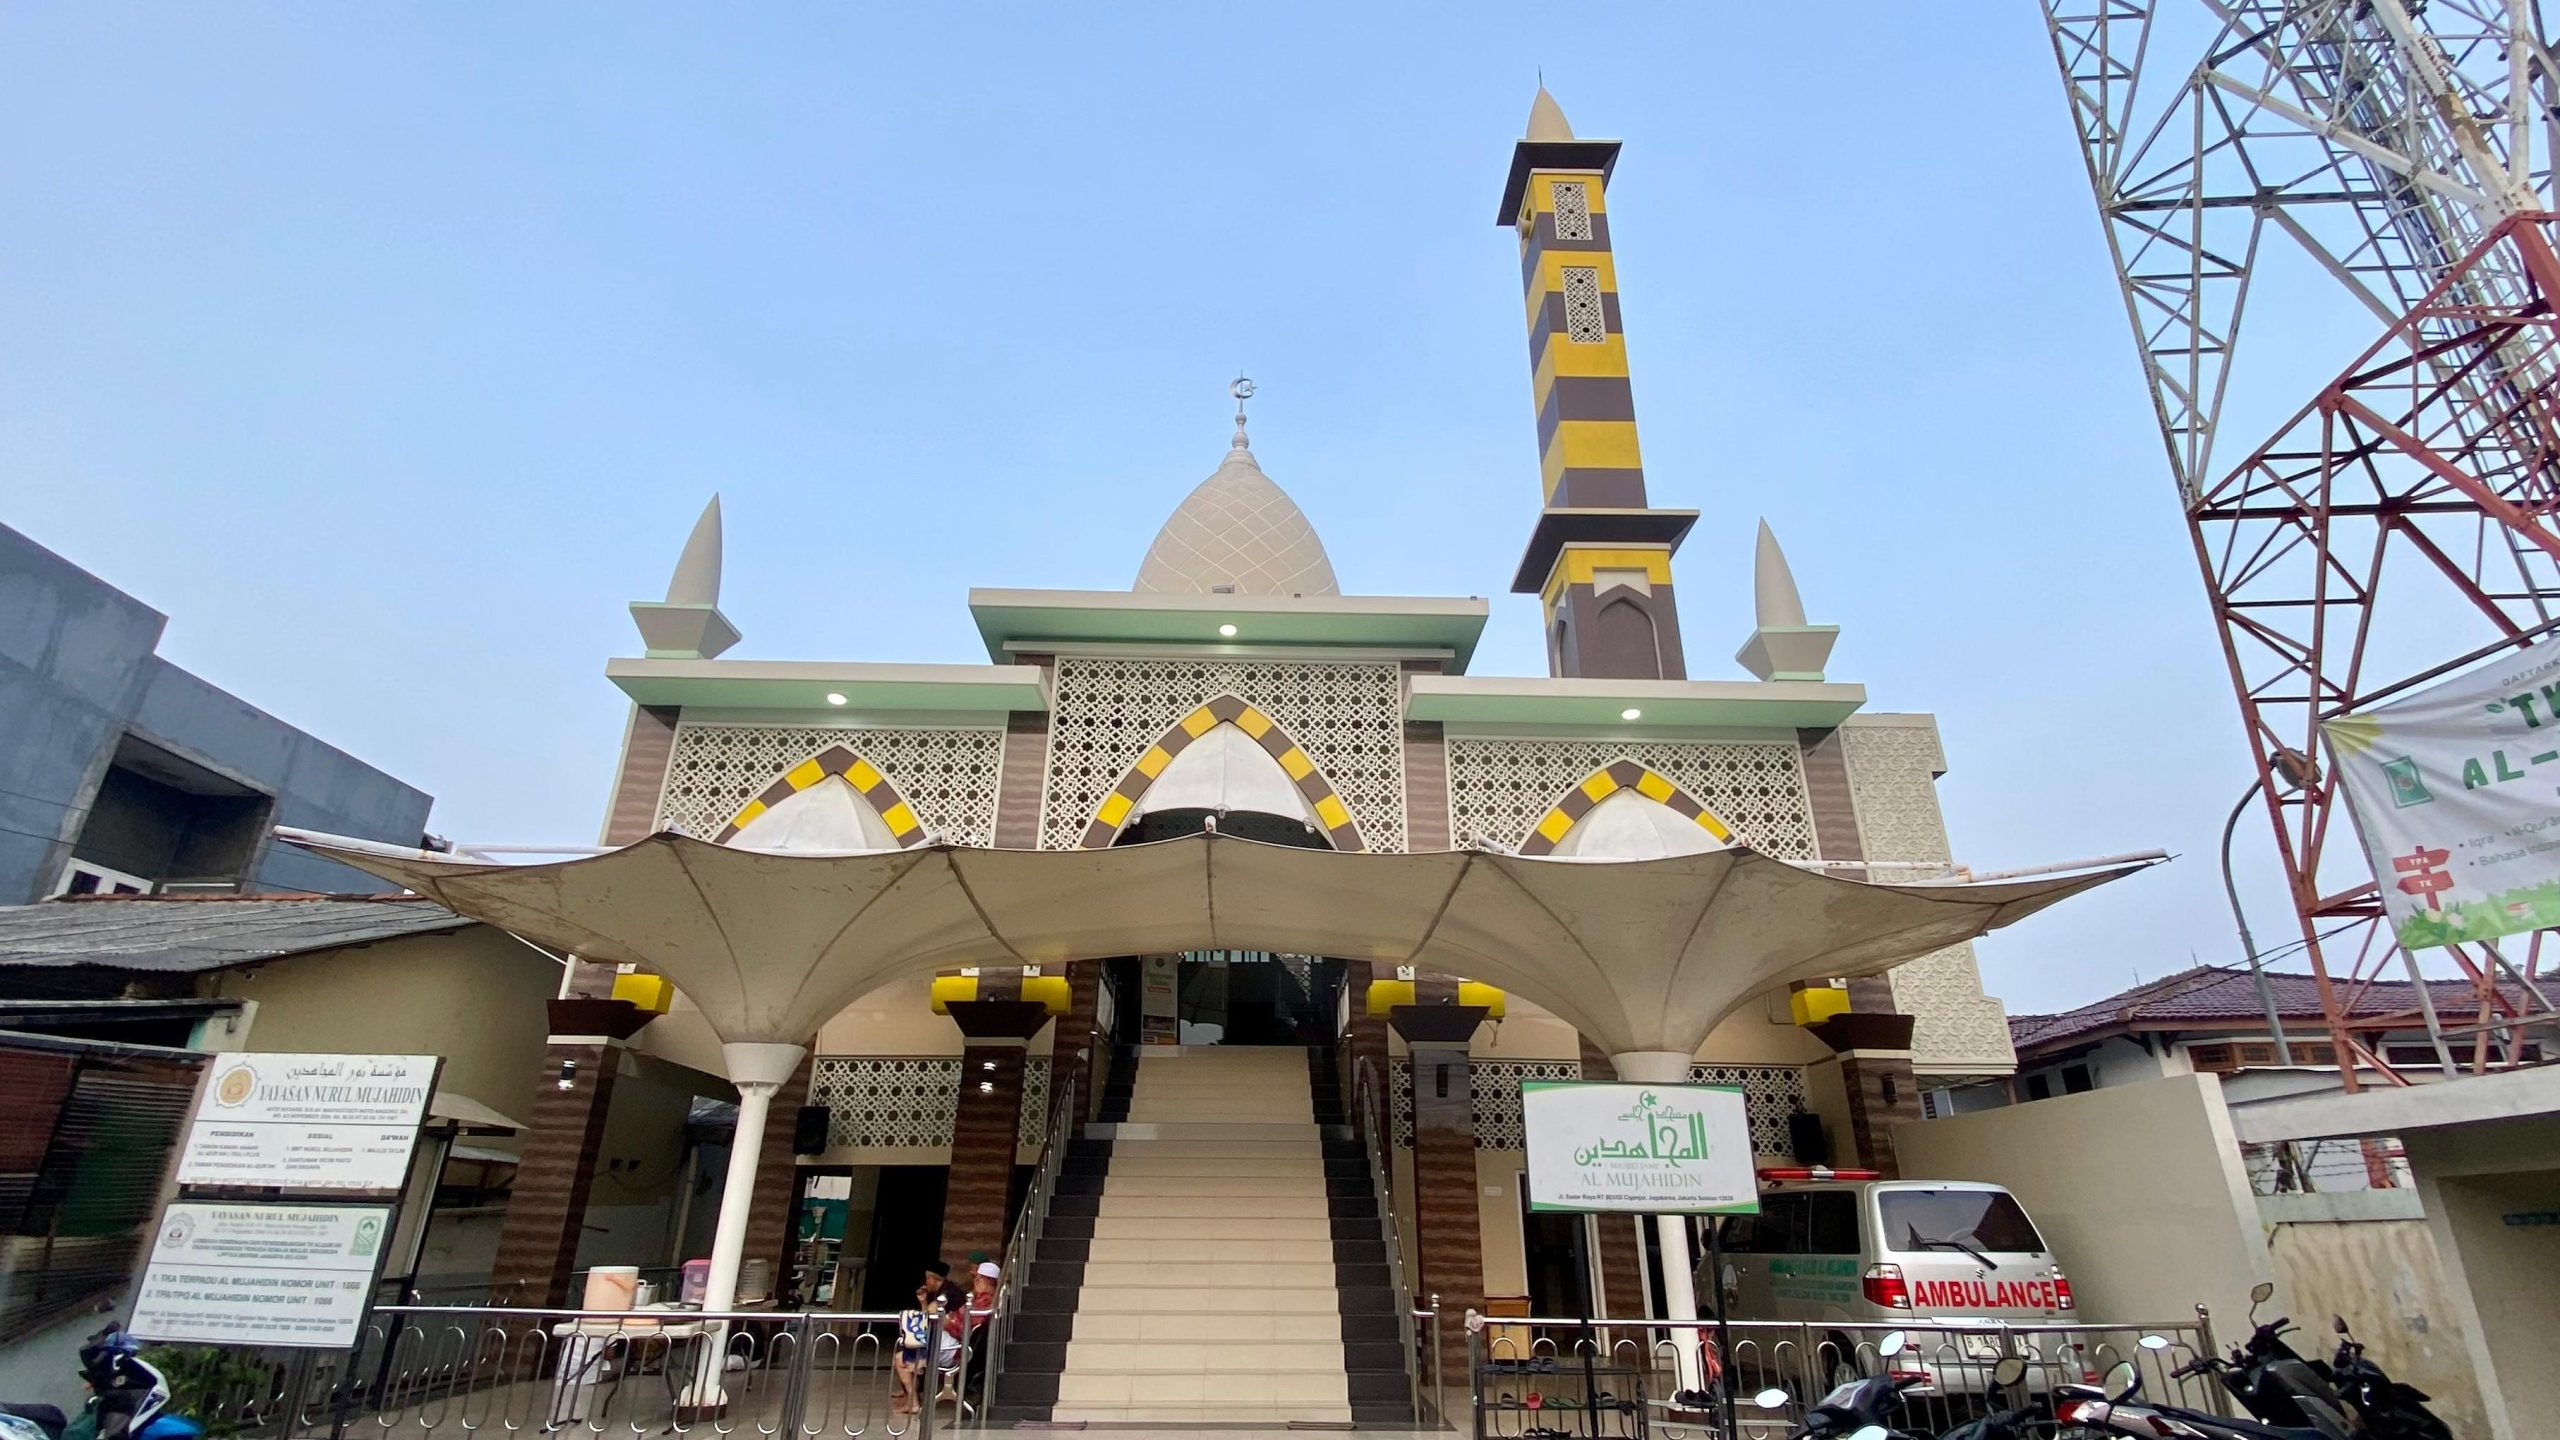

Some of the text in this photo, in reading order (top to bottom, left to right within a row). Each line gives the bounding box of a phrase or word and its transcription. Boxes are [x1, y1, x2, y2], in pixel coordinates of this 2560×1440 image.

[2409, 856, 2430, 866] TPA
[2479, 849, 2526, 867] Bahasa
[259, 1085, 424, 1104] YAYASAN NURUL MUJAHIDIN
[1580, 1172, 1703, 1191] AL MUJAHIDIN
[212, 1211, 339, 1223] YAYASAN NURUL MUJAHIDIN
[160, 1274, 177, 1284] TKA
[218, 1276, 229, 1286] AL
[232, 1277, 280, 1287] MUJAHIDIN
[281, 1278, 313, 1288] NOMOR
[315, 1280, 335, 1290] UNIT
[191, 1292, 203, 1301] AL
[204, 1292, 250, 1302] MUJAHIDIN
[251, 1294, 285, 1304] NOMOR
[287, 1295, 307, 1305] UNIT
[1914, 1280, 2057, 1308] AMBULANCE
